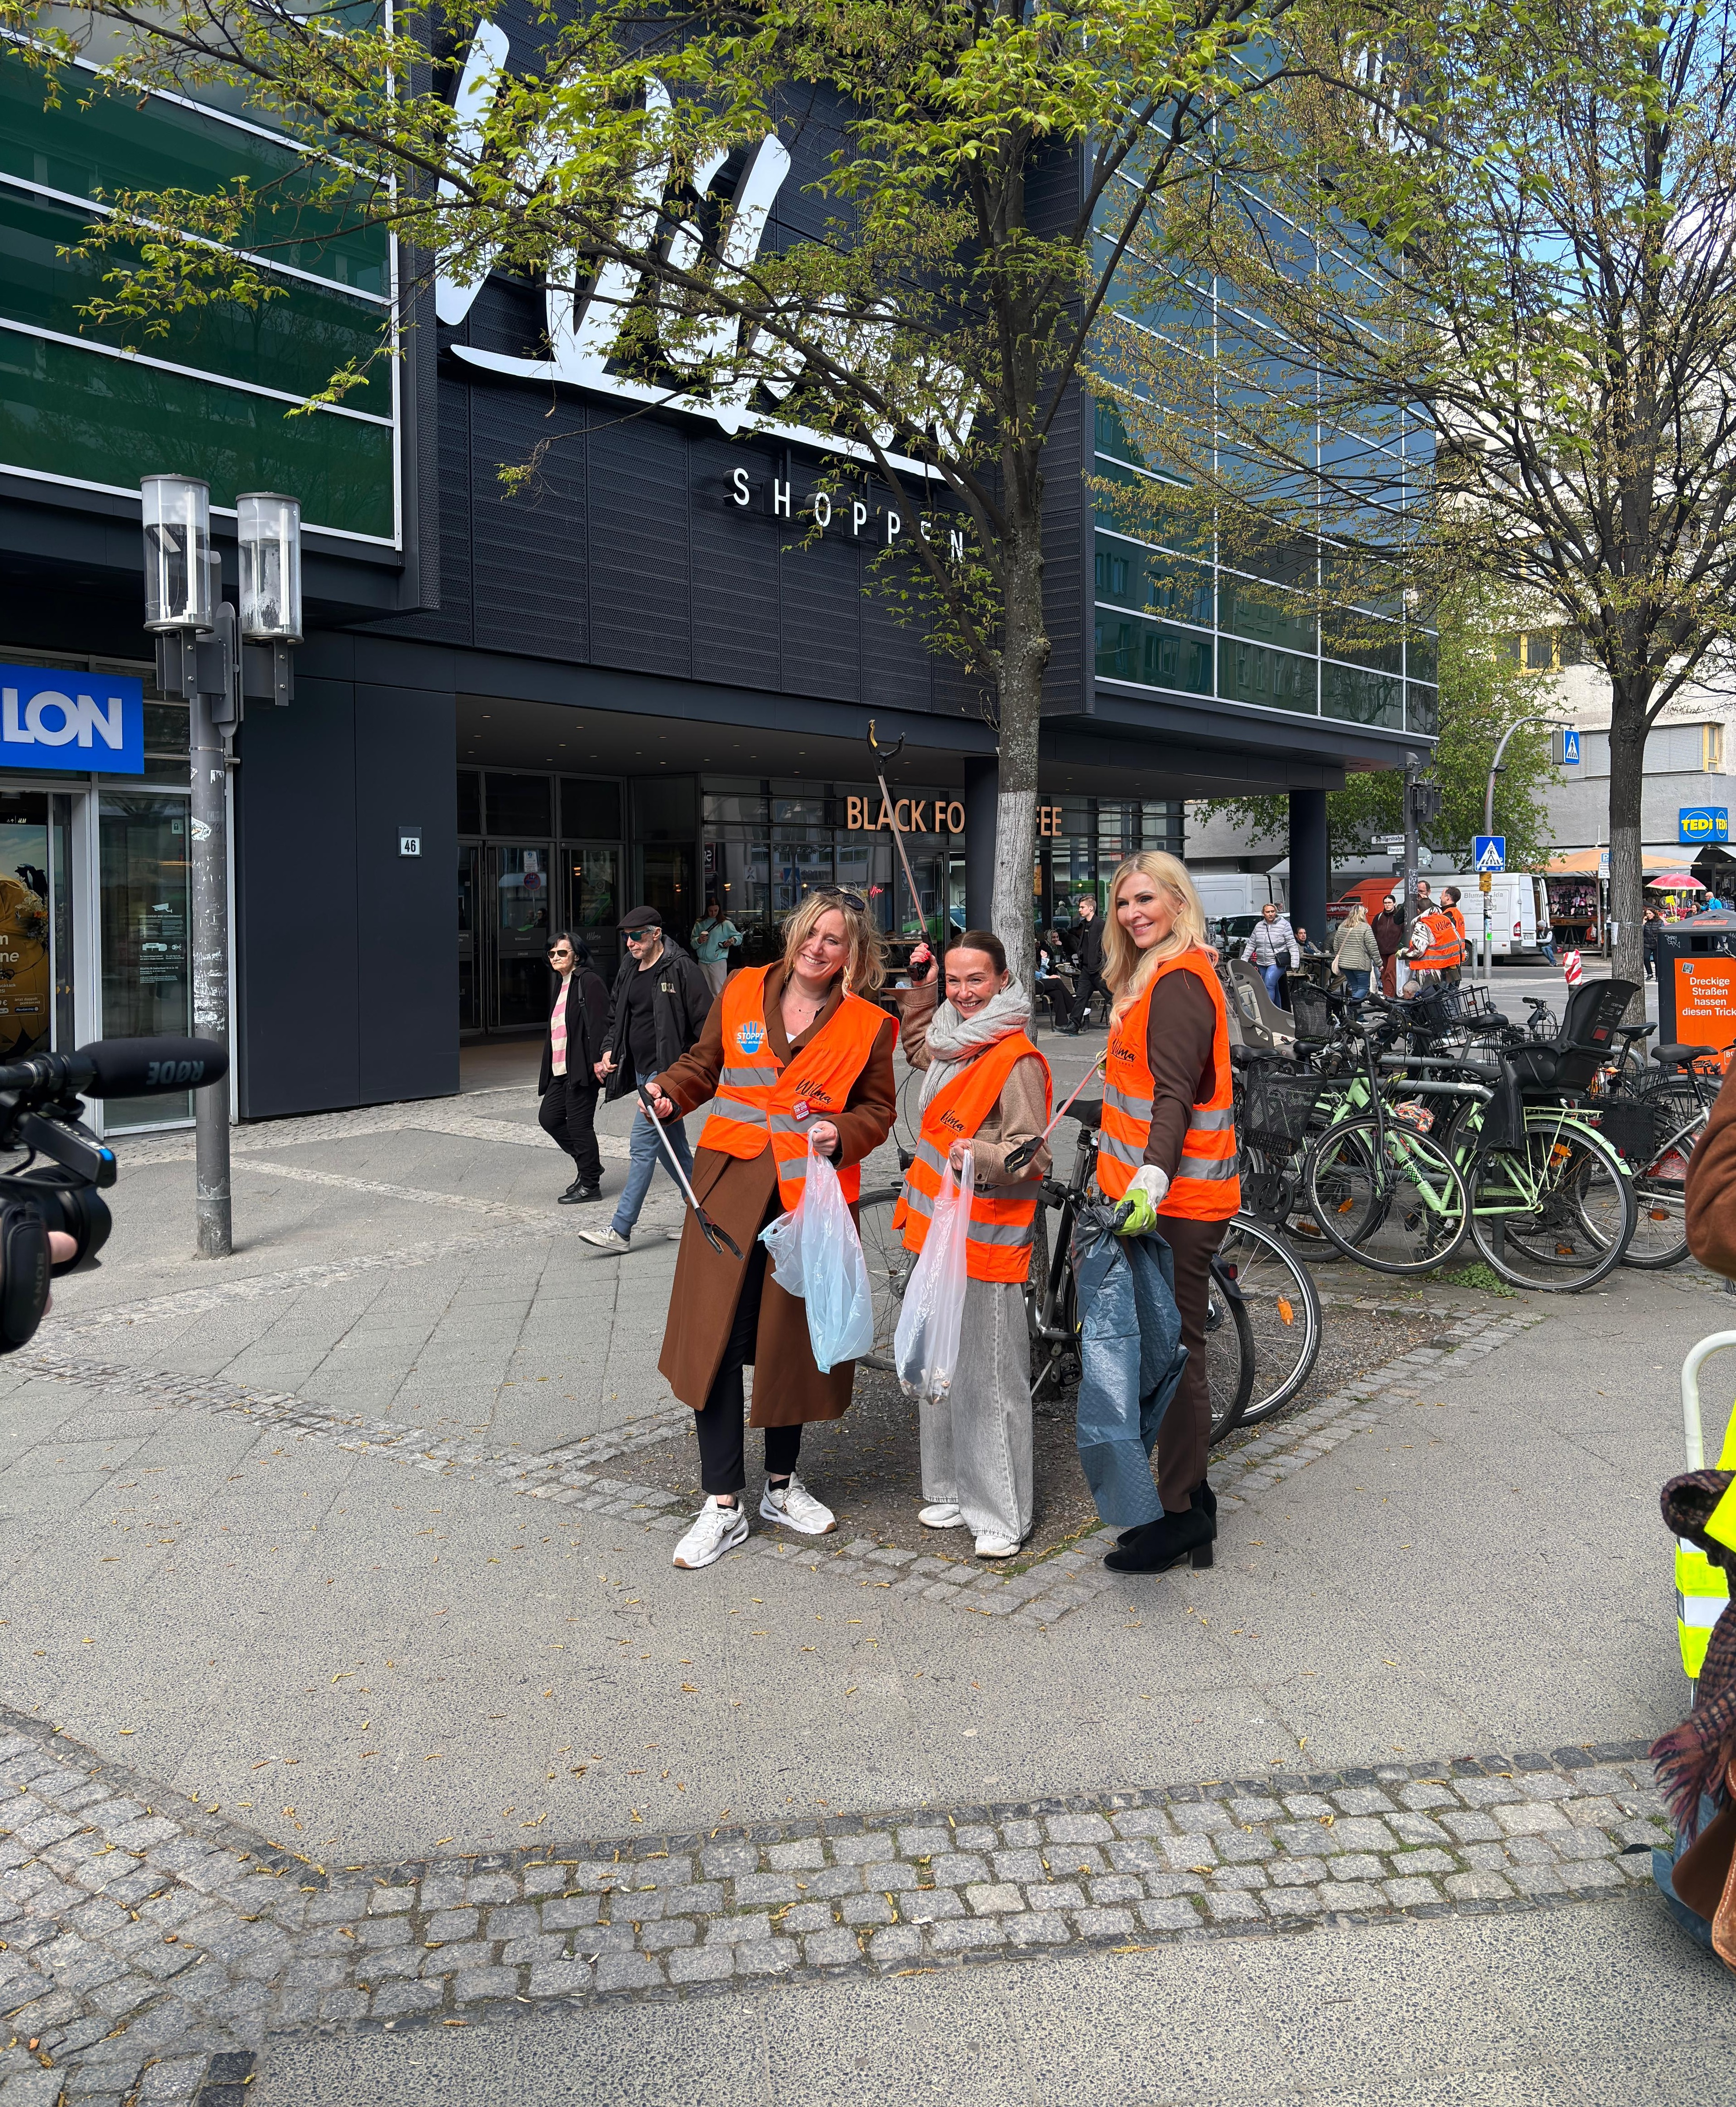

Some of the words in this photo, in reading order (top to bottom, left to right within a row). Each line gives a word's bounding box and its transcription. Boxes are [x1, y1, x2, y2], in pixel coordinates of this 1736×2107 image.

[846, 796, 927, 832] BLACK
[1681, 818, 1713, 831] TEDi
[1715, 818, 1727, 830] TEDi
[404, 840, 416, 852] 46
[1690, 977, 1730, 986] Dreckige
[1692, 987, 1728, 995] Straßen
[1682, 1008, 1712, 1016] diesen
[736, 1032, 765, 1040] STOPPT
[146, 1060, 204, 1085] RØDE
[795, 1078, 833, 1104] Wilma
